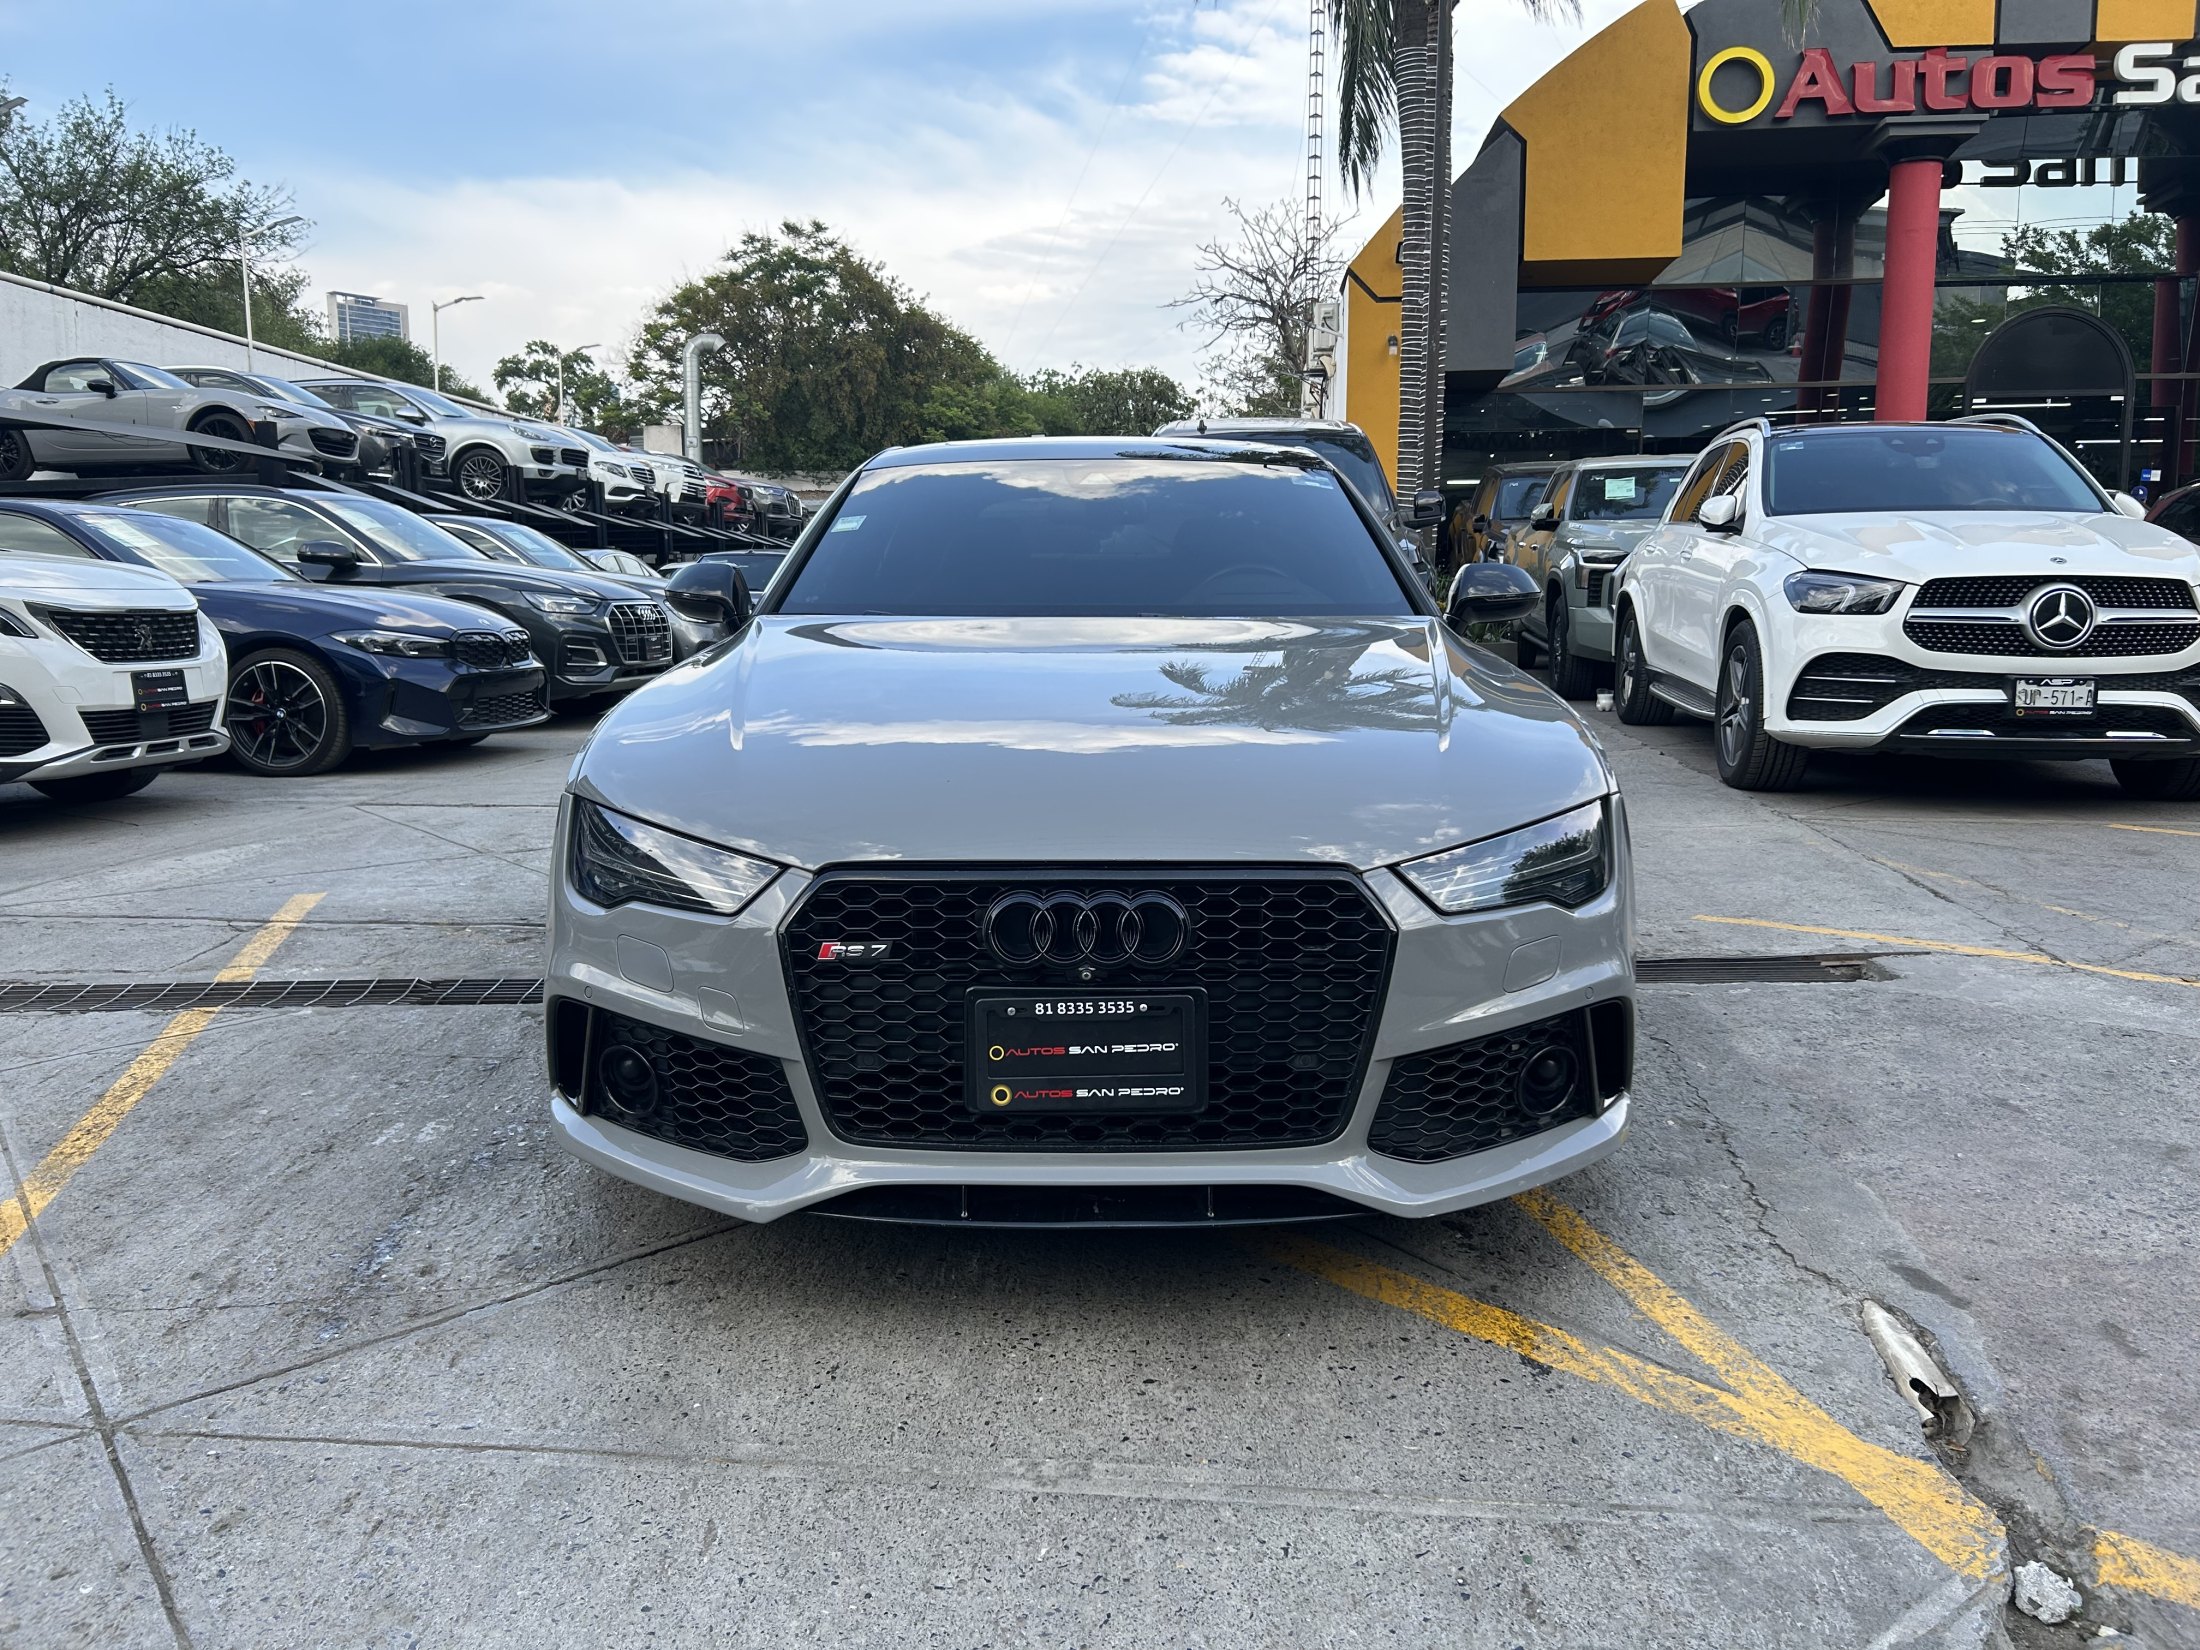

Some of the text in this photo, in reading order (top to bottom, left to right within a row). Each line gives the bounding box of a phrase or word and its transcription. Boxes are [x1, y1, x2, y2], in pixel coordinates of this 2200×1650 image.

[1774, 47, 2096, 119] Autos
[829, 945, 888, 957] RS 7
[1035, 1001, 1135, 1015] 81 8335 3535
[1006, 1047, 1066, 1057] AUTOS
[1068, 1045, 1108, 1055] SAN
[1014, 1089, 1073, 1099] AUTOS
[1076, 1088, 1115, 1097] SAN
